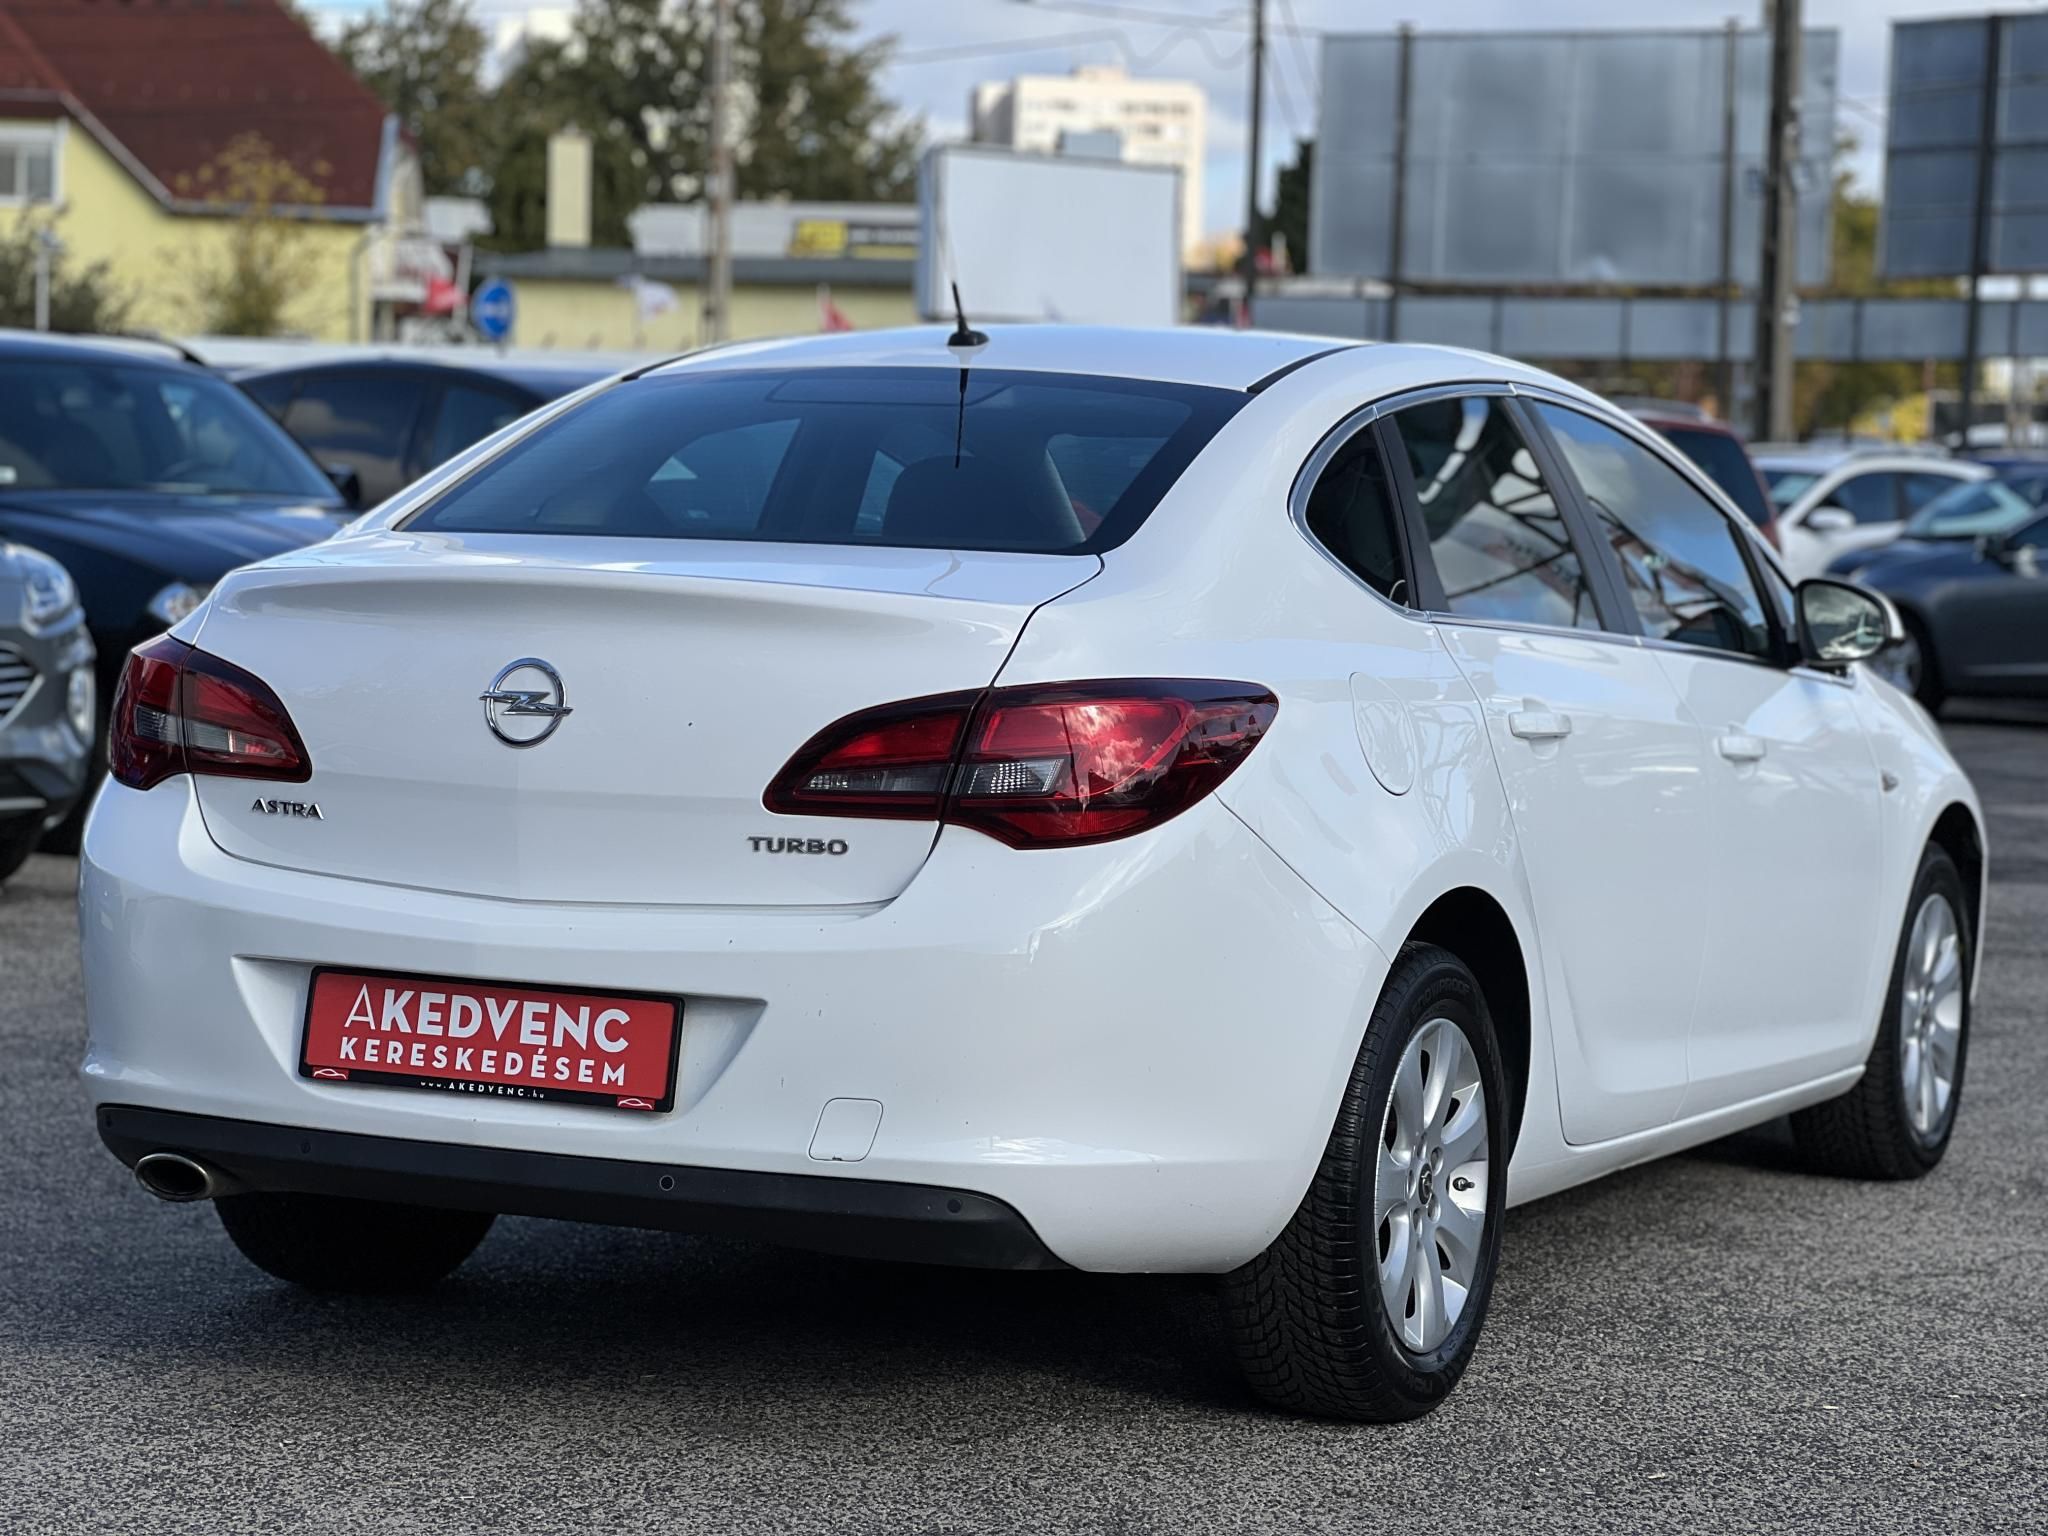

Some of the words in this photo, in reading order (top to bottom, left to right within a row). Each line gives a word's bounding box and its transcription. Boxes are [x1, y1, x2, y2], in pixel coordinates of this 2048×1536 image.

[251, 797, 324, 820] ASTRA
[746, 835, 849, 856] TURBO
[344, 983, 631, 1054] AKEDVENC
[339, 1036, 627, 1087] KERESKEDÉSEM
